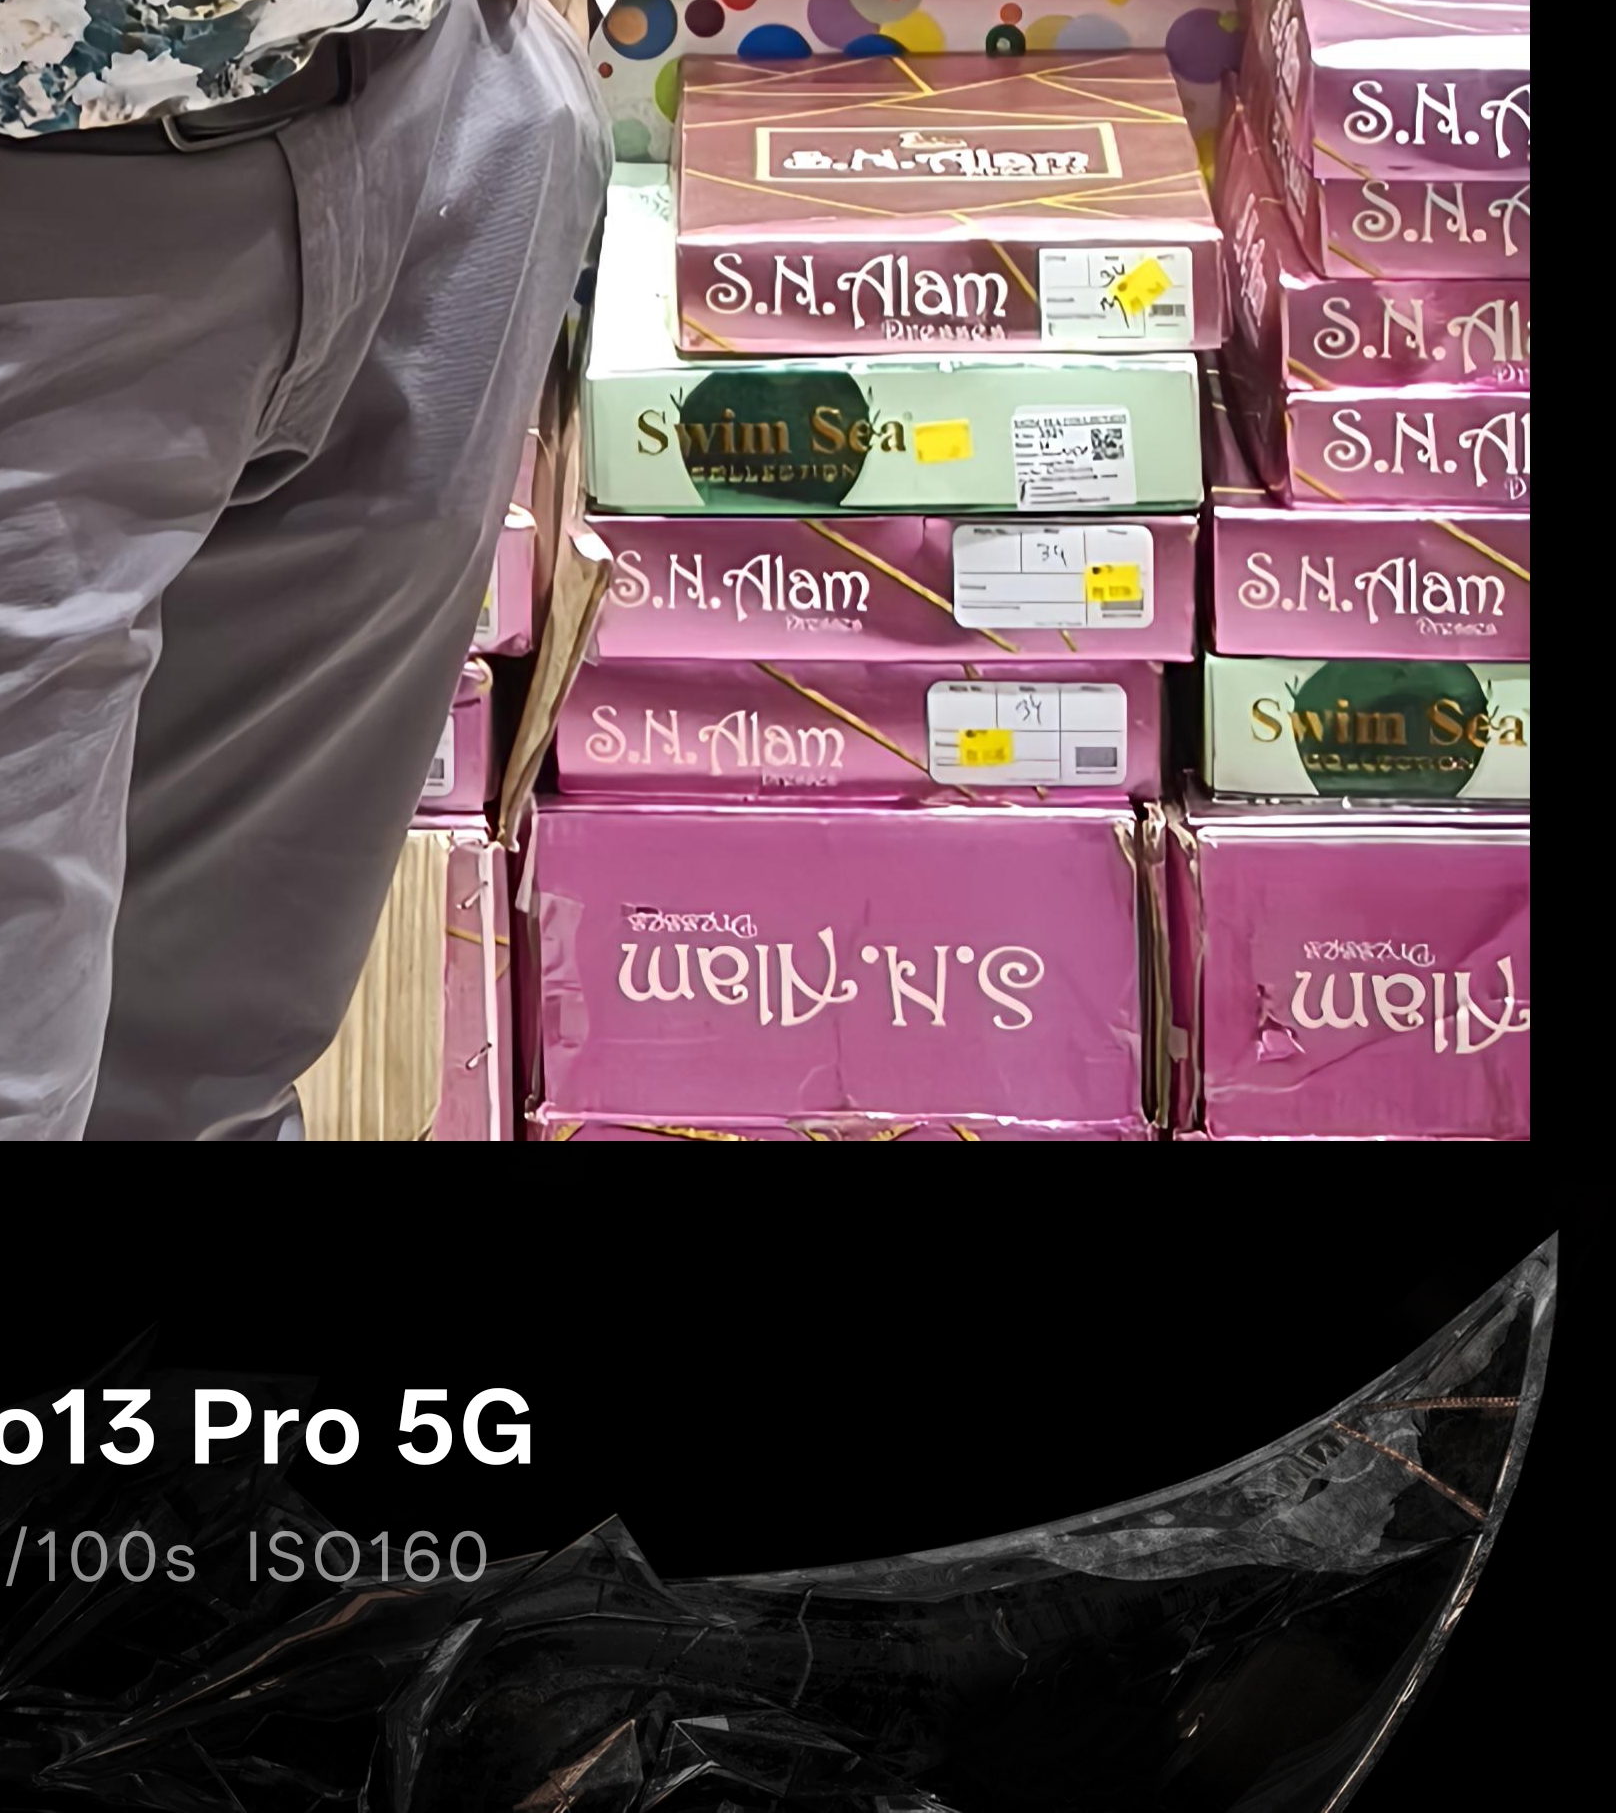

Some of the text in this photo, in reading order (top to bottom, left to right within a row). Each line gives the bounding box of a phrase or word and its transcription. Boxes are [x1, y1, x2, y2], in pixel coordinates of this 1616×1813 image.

[1343, 80, 1530, 158] S.N.A
[1351, 179, 1530, 257] S.N.A
[705, 252, 1009, 331] S.N.Alam
[1313, 296, 1530, 373] S.N.Al
[637, 400, 909, 458] Swim Sea
[1322, 406, 1530, 487] S.N.Al
[604, 548, 871, 620] S.N.Alam
[1236, 551, 1506, 620] S.N.Alam
[583, 704, 846, 775] S.N.Alam
[1249, 694, 1527, 749] Swim Sea
[616, 927, 1045, 1032] S.N.Alam
